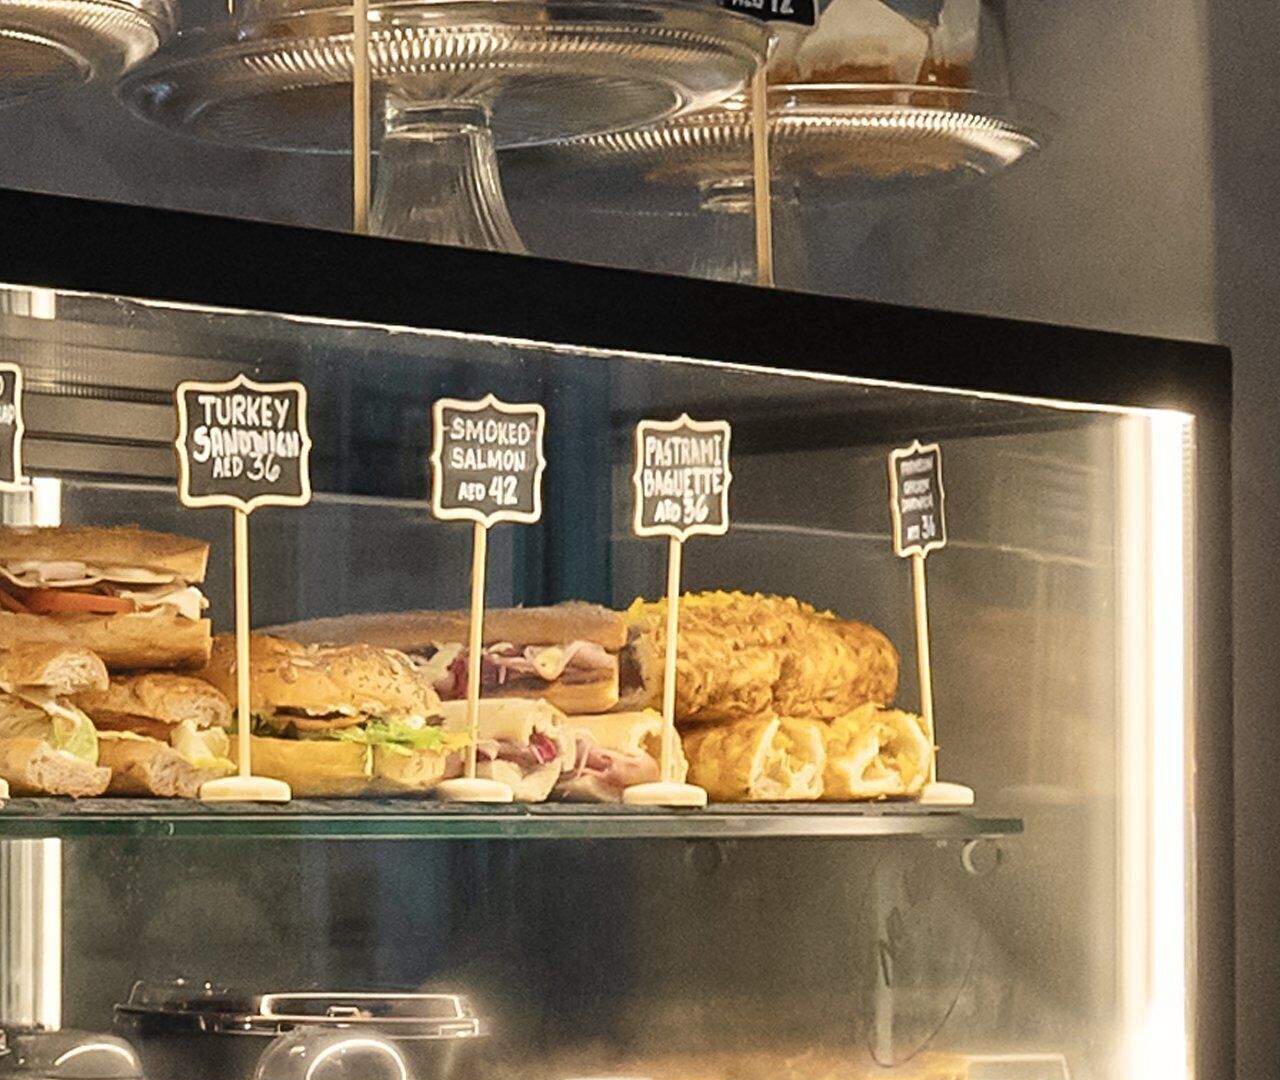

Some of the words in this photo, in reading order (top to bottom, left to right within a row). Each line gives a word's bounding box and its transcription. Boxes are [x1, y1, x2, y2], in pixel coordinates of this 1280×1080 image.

[198, 394, 290, 429] TURKEY
[192, 425, 300, 462] SANDWICH
[450, 417, 531, 446] SMOKED
[451, 447, 526, 472] SALMON
[645, 434, 722, 467] PASTRAMI
[212, 456, 244, 479] AED
[246, 452, 282, 482] 36
[643, 466, 723, 498] BAGUETTE
[458, 481, 486, 501] AED
[488, 475, 518, 505] 42
